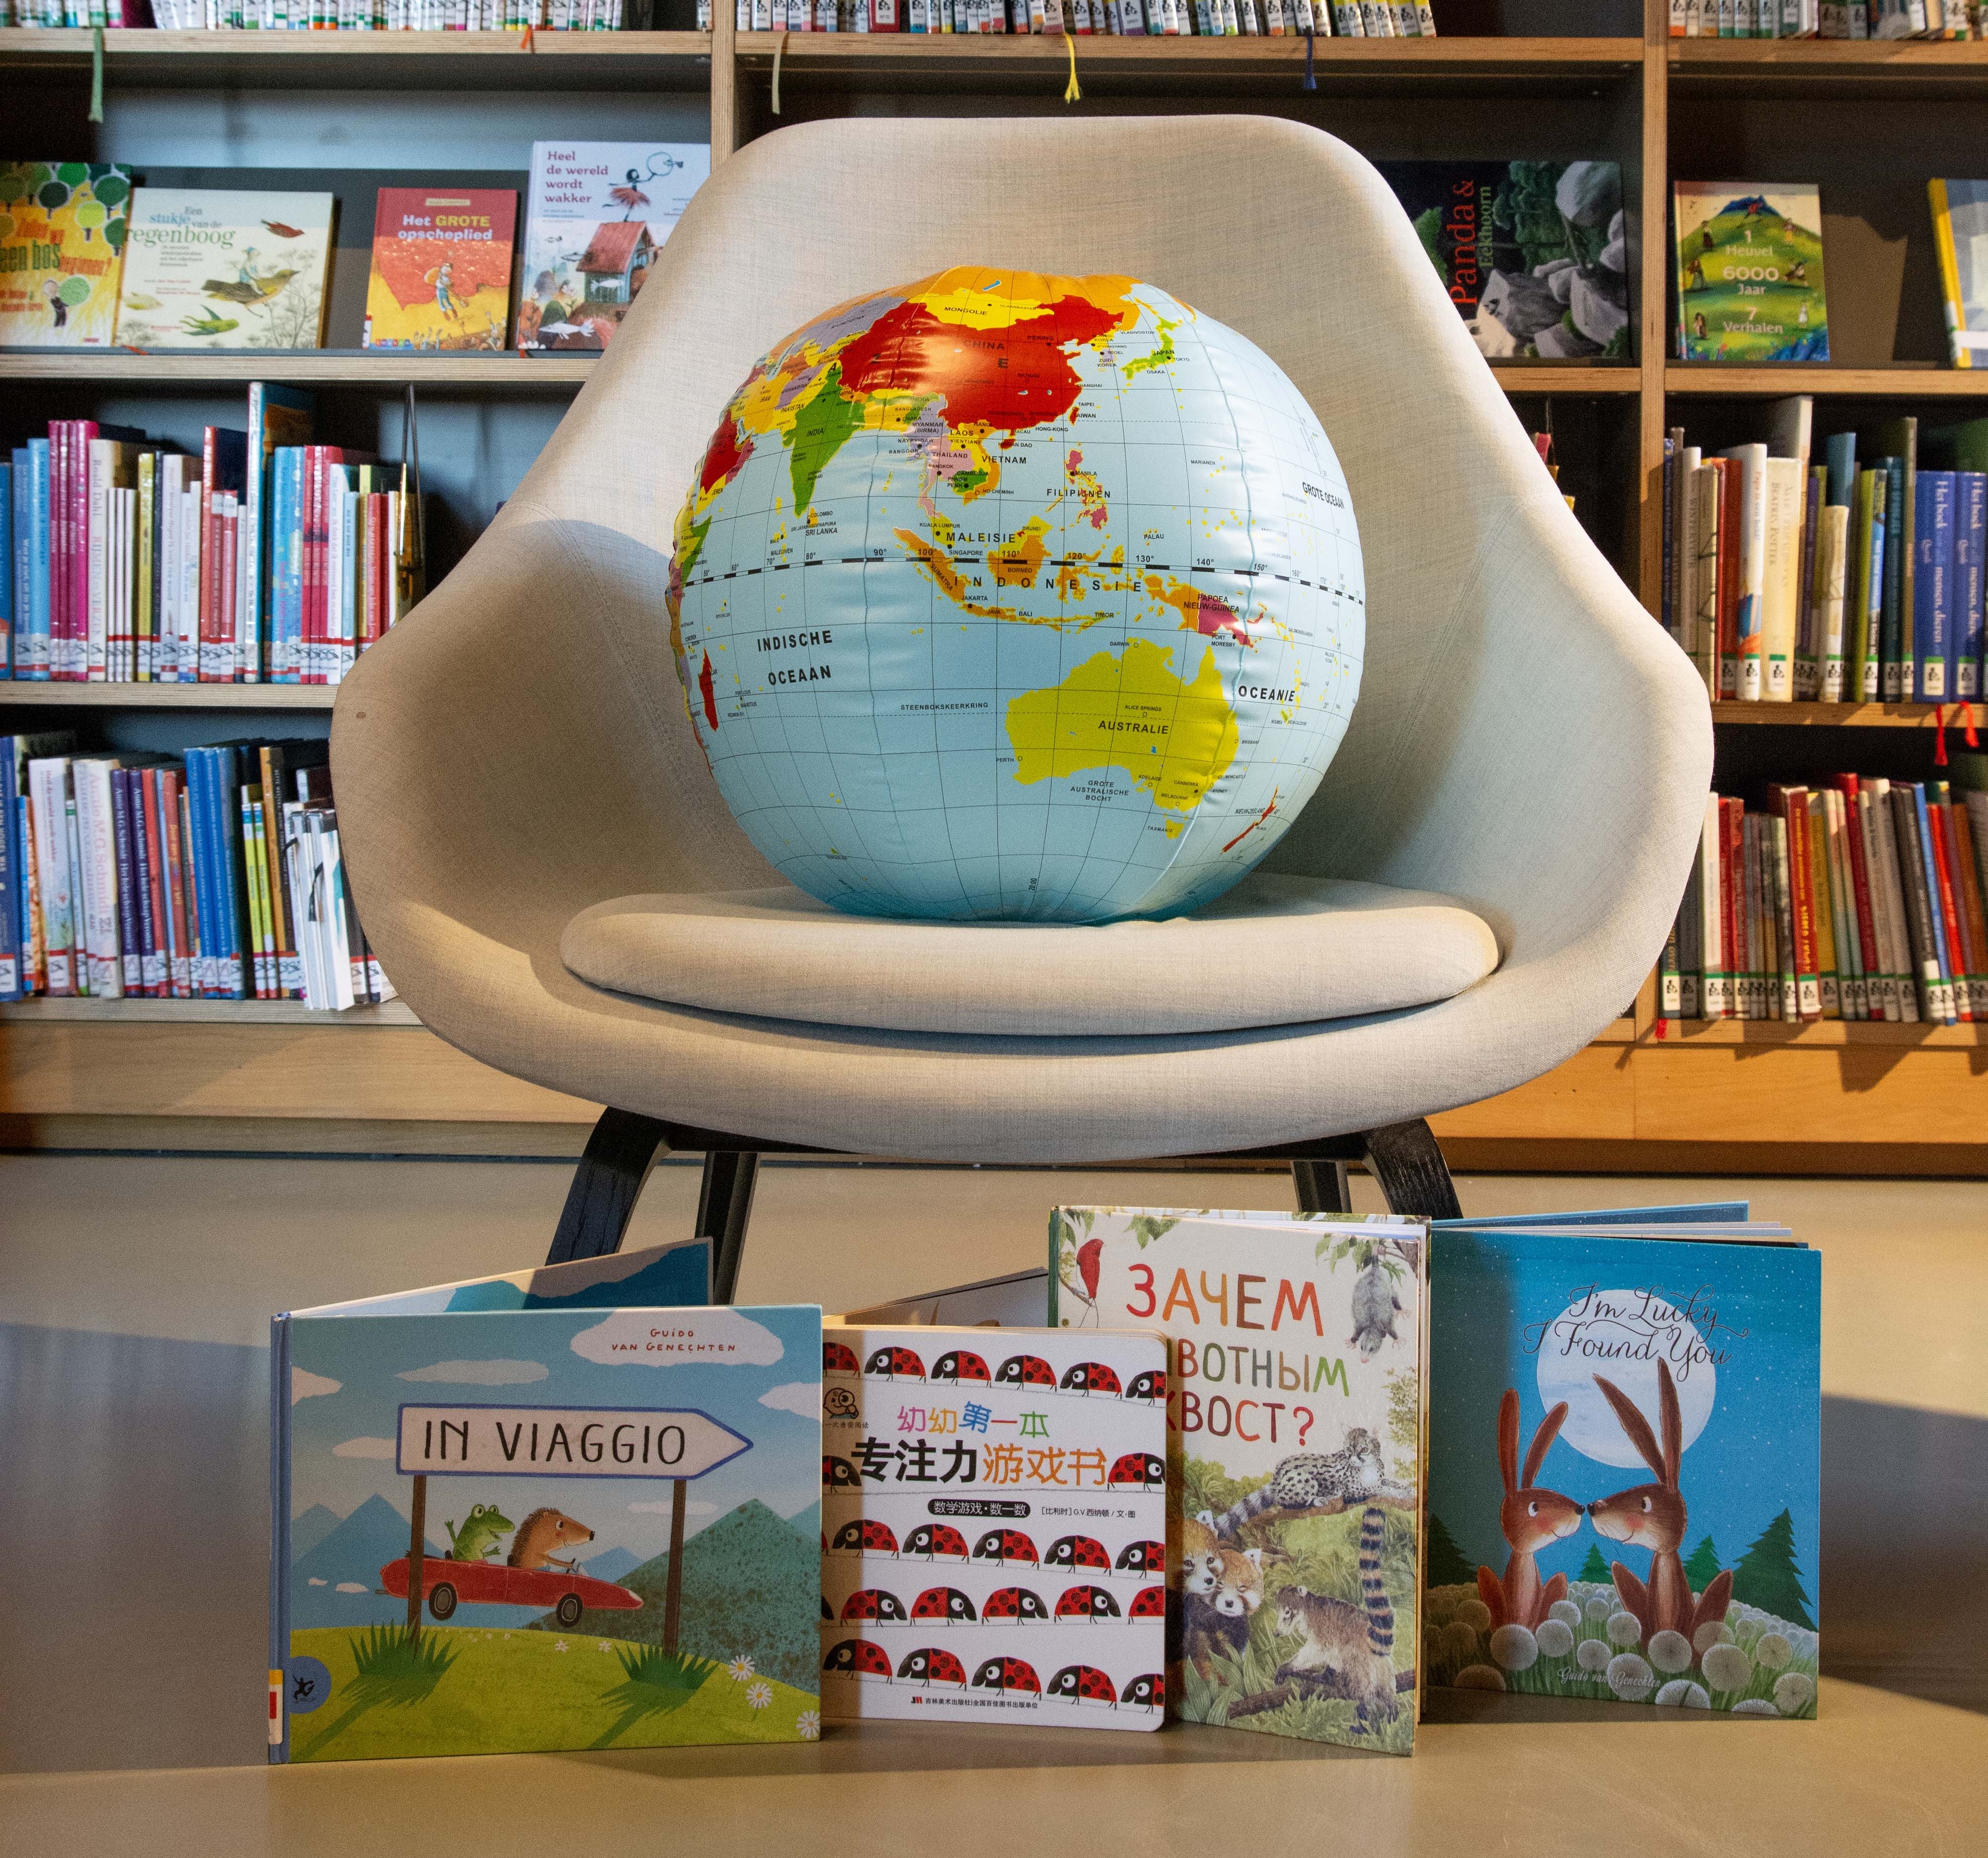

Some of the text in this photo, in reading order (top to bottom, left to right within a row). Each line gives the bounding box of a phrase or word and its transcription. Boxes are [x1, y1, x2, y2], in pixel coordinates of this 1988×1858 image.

[547, 151, 576, 161] Heel
[547, 165, 608, 175] de wereld
[546, 179, 582, 189] wordt
[545, 193, 592, 203] wakker
[402, 214, 491, 227] Het GROTE
[397, 228, 493, 243] opscheplied
[1447, 179, 1477, 305] Panda &
[1744, 230, 1751, 243] 1
[1726, 245, 1773, 256] Heuvel
[1723, 266, 1779, 281] 6000
[1738, 284, 1766, 294] Jaar
[944, 307, 988, 316] MONGOLIE
[1746, 307, 1758, 321] 7
[1724, 321, 1784, 334] Verhalen
[963, 340, 1005, 350] CHINA
[781, 404, 805, 413] PAKISTAN
[807, 427, 824, 437] INDIA
[1302, 482, 1345, 509] GROTE OCEAAN
[93, 493, 102, 516] Dahl
[946, 532, 1016, 543] MALEISIE
[771, 548, 793, 556] MALEDIVEN
[930, 563, 953, 591] SUMATRA
[954, 576, 1142, 592] INDONESIE
[1197, 594, 1229, 603] PAPOEA
[1183, 601, 1240, 613] NIEUW-GUINEA
[757, 630, 833, 652] INDISCHE
[768, 666, 831, 685] OCEAAN
[1238, 685, 1295, 701] OCEANIE
[1098, 720, 1168, 735] AUSTRALIE
[1071, 786, 1129, 796] AUSTRALISCHE
[115, 788, 124, 810] Annie
[118, 829, 128, 859] Schmidt
[1028, 878, 1038, 891] 20:00
[1126, 1263, 1324, 1337] ЗАЧЕМ
[1569, 1281, 1749, 1344] I'm Lucky
[646, 1343, 736, 1353] GENECHTEN
[1523, 1319, 1733, 1382] I Found You
[1166, 1338, 1349, 1397] ВОТНЫМ
[897, 1401, 1050, 1438] 幼幼第一本
[424, 1420, 685, 1464] IN VIAGGIO
[851, 1437, 1107, 1486] 专注力游戏书
[1557, 1666, 1661, 1689] Guido van Genechten
